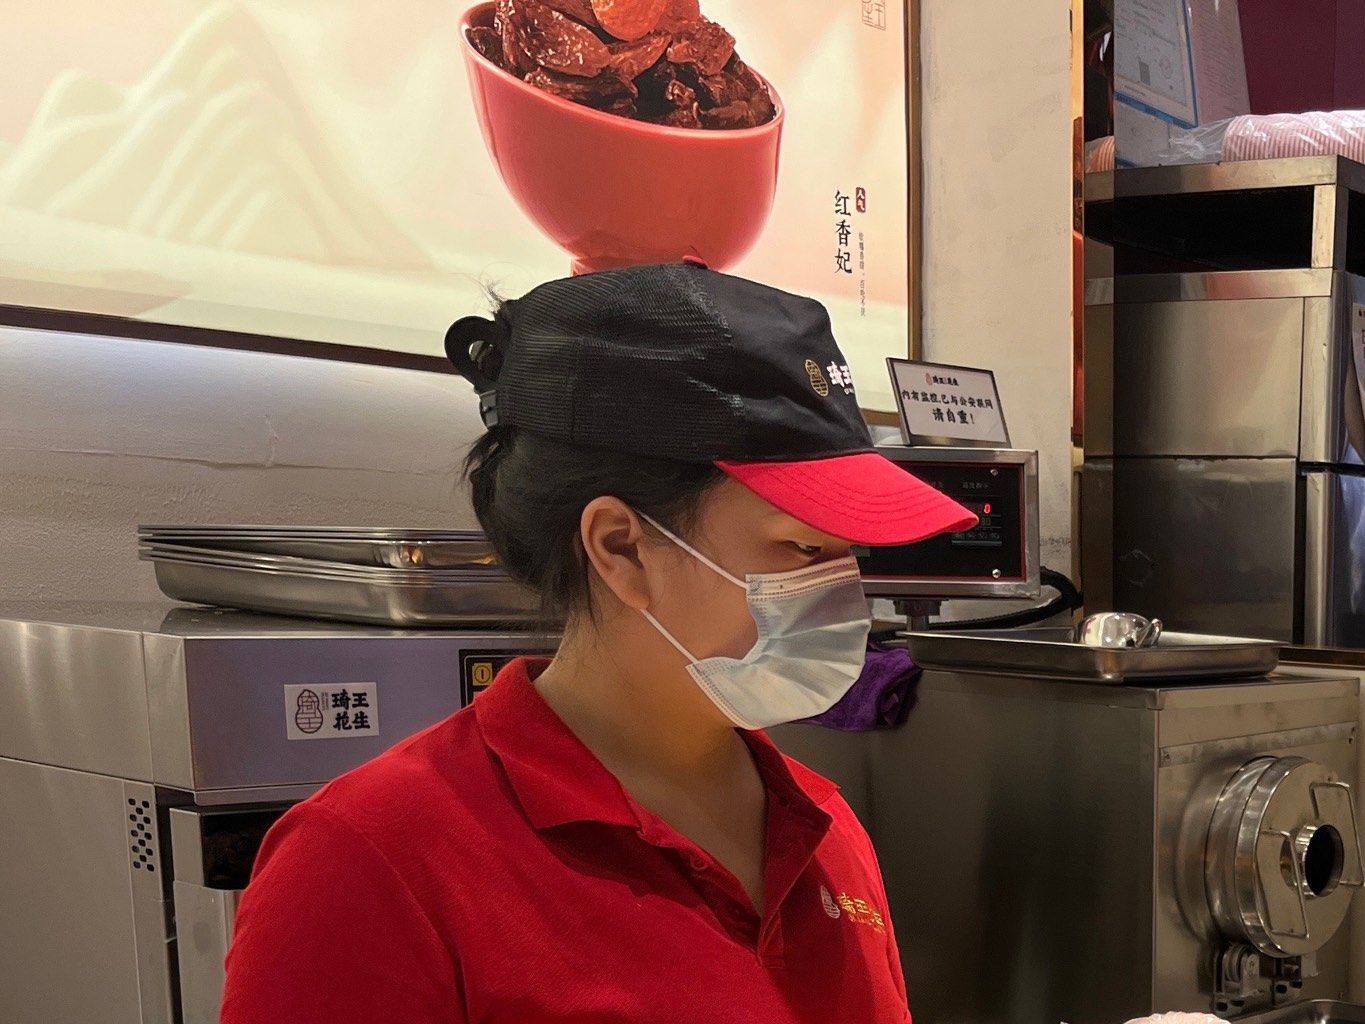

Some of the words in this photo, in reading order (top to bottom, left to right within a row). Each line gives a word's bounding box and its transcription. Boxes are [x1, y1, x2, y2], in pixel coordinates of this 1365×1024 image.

[835, 190, 852, 274] 红香妃
[331, 689, 370, 711] 琦王
[333, 711, 371, 731] 花生
